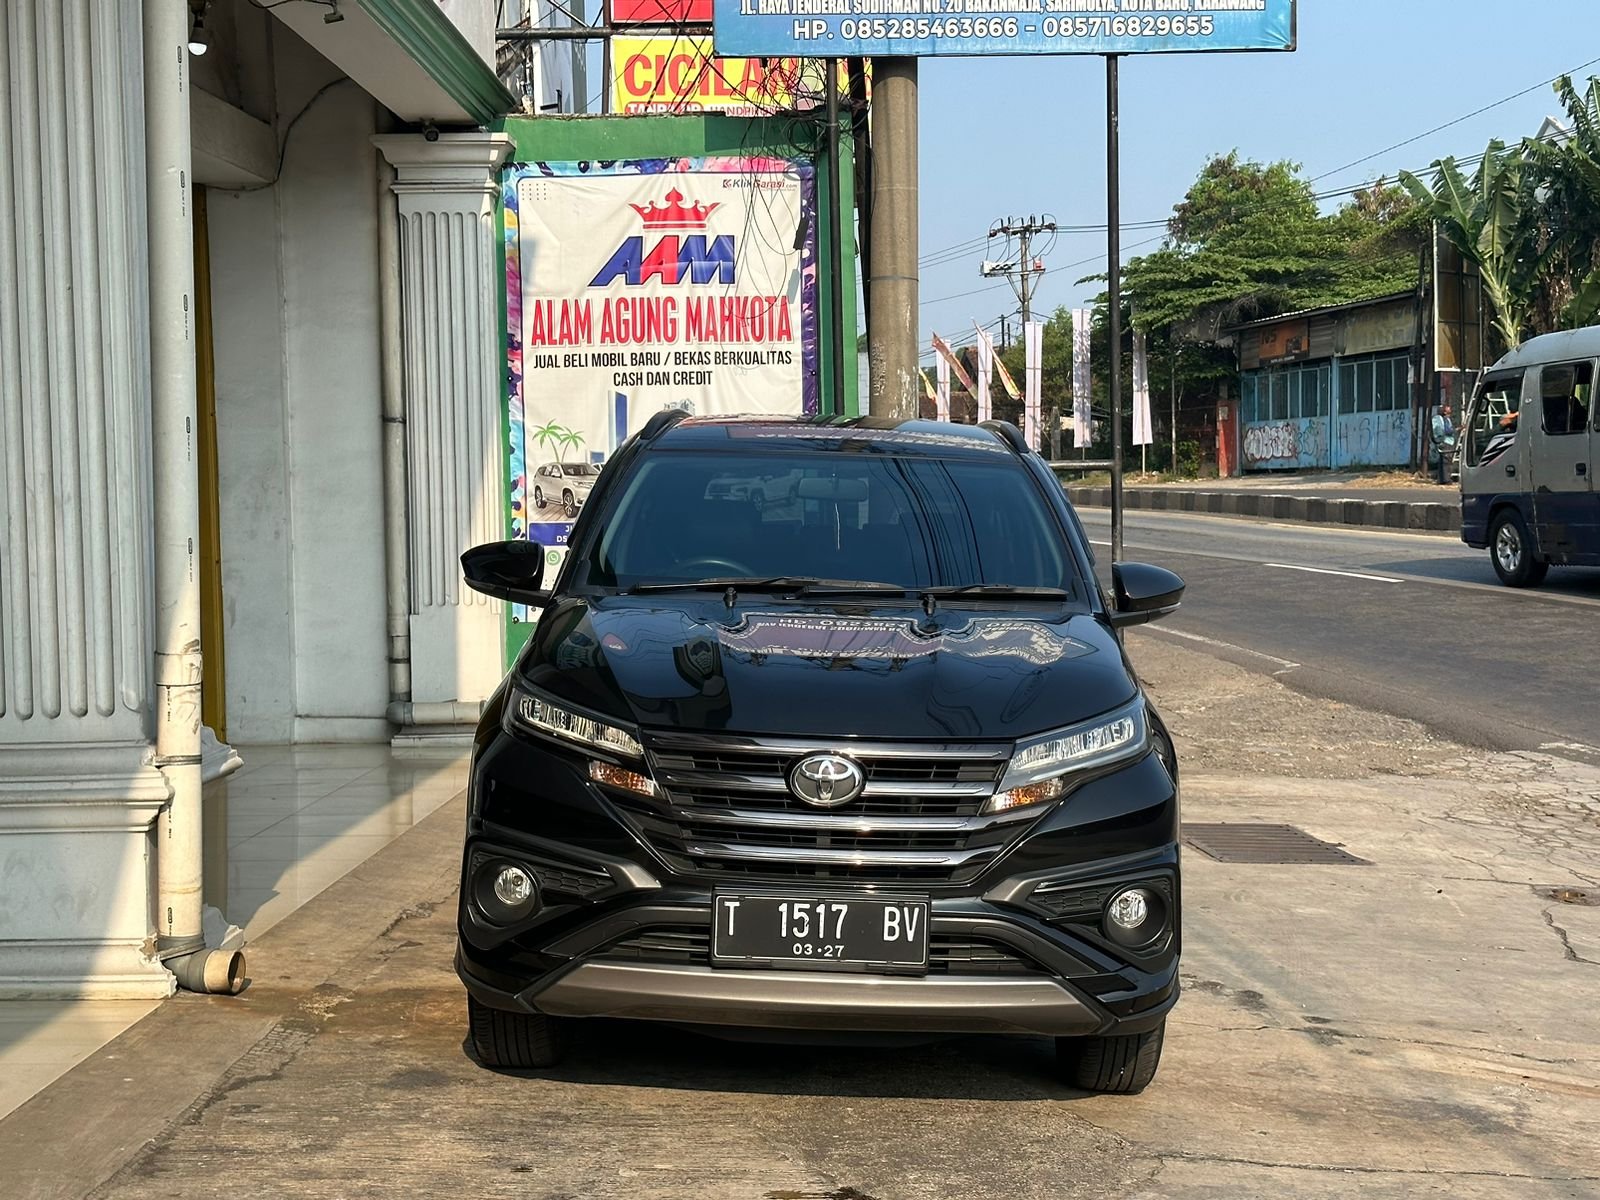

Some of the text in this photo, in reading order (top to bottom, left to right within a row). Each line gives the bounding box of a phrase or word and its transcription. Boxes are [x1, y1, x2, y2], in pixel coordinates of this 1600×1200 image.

[758, 0, 790, 14] RAYA
[792, 0, 851, 14] JENDERAL
[853, 0, 921, 14] SUDIRMAN
[793, 18, 834, 40] HP.
[840, 17, 1018, 39] 085285463666
[1042, 15, 1214, 38] 085716829655
[588, 235, 735, 287] AAM
[531, 295, 792, 346] ALAM AGUNG MAHKOTA
[534, 350, 792, 369] JUAL BELI MOBIL BARU / BEKAS BERKUALITAS
[613, 371, 713, 386] CASH DAN CREDIT
[724, 902, 920, 942] T 1517 BV
